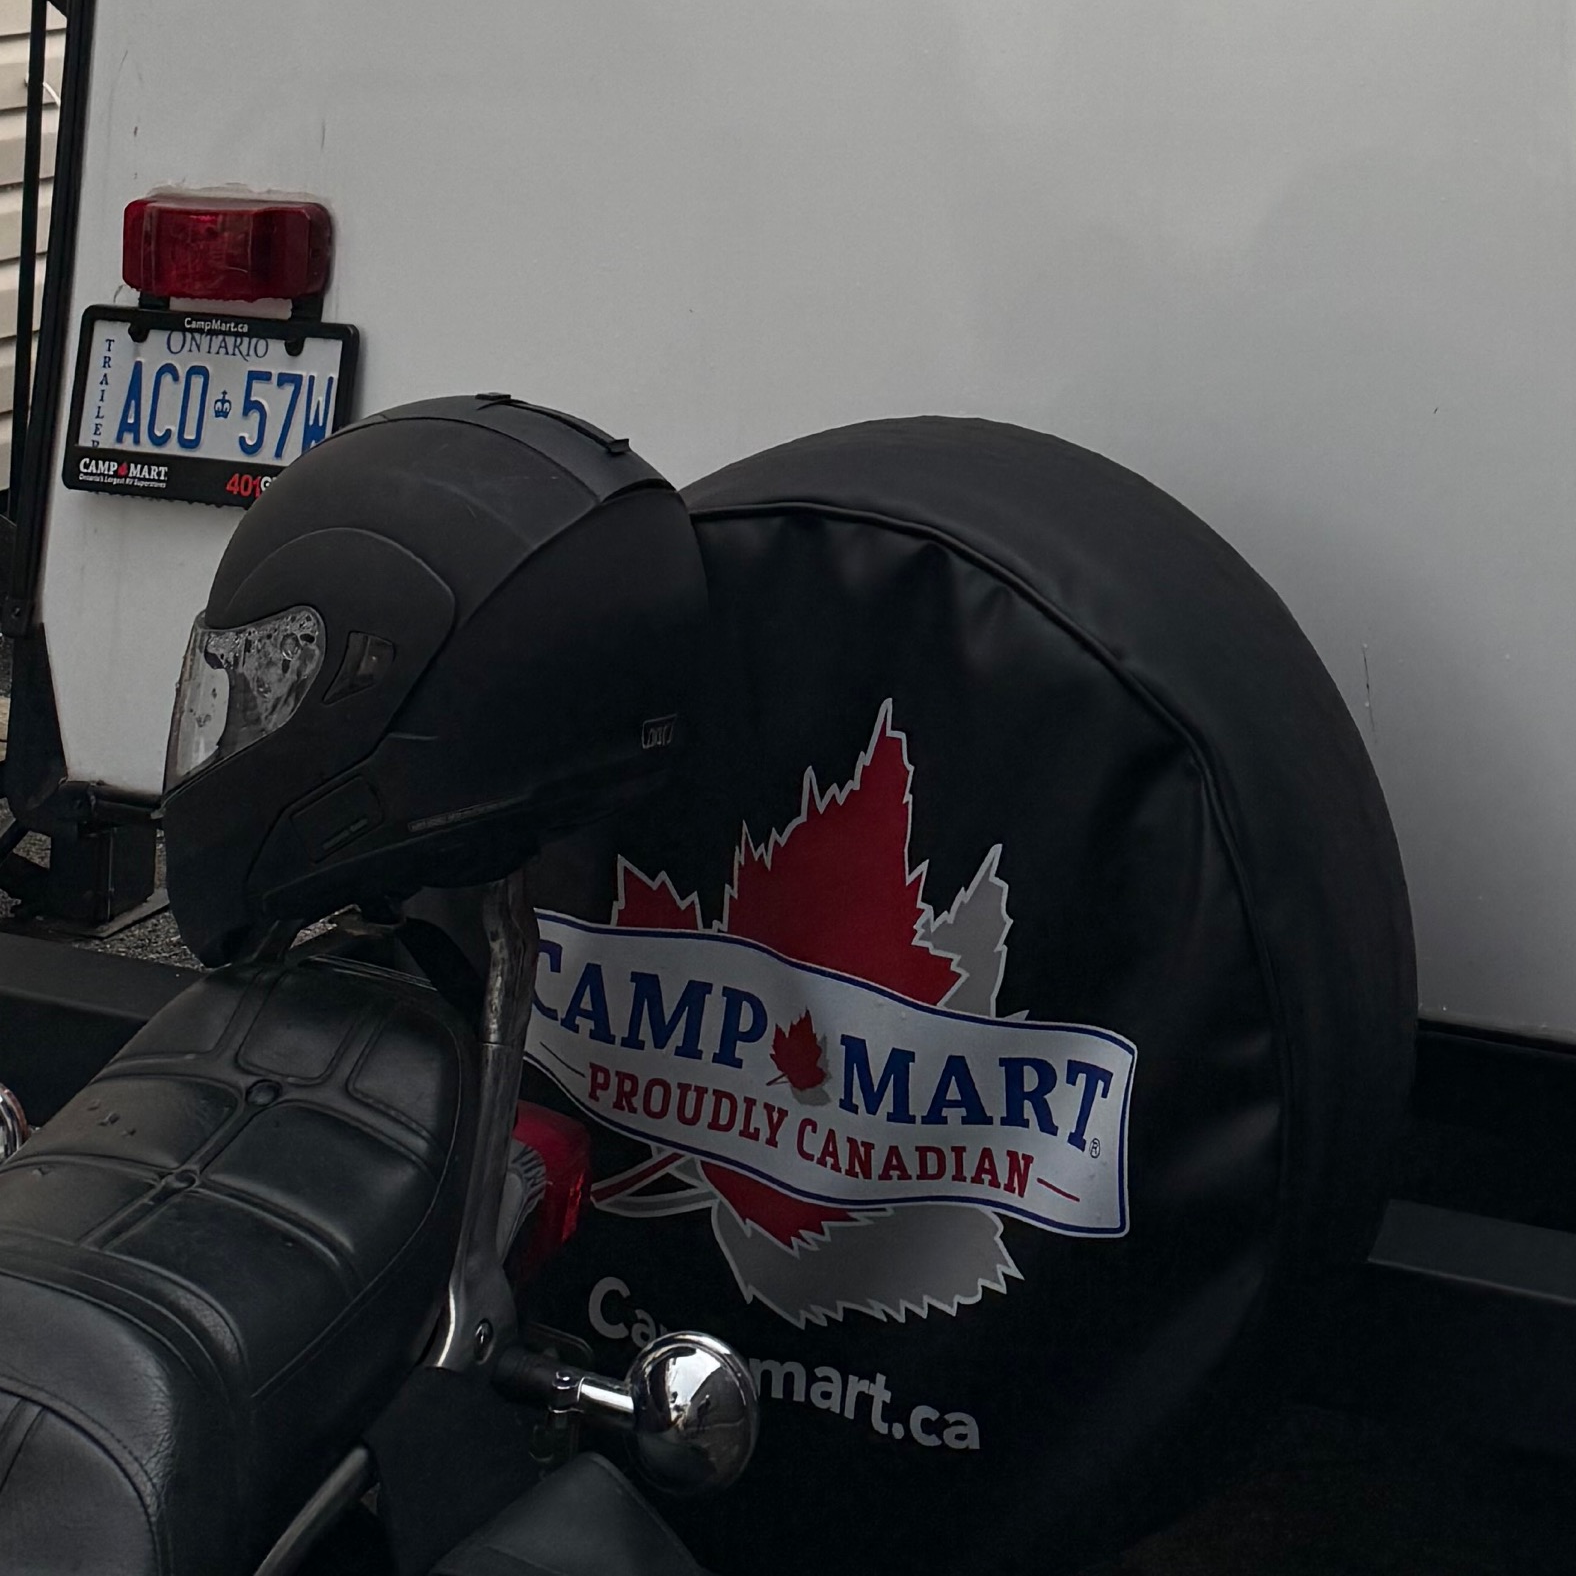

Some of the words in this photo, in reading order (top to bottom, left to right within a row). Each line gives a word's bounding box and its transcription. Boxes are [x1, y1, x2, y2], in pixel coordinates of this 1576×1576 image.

[166, 330, 269, 361] ONTARIO
[184, 317, 249, 334] CampMart.ca
[238, 369, 335, 460] 57W
[79, 457, 118, 475] CAMP
[128, 463, 168, 480] MART
[839, 1033, 1114, 1152] MART
[588, 1061, 789, 1148] PROUDLY
[796, 1117, 1035, 1198] CANADIAN
